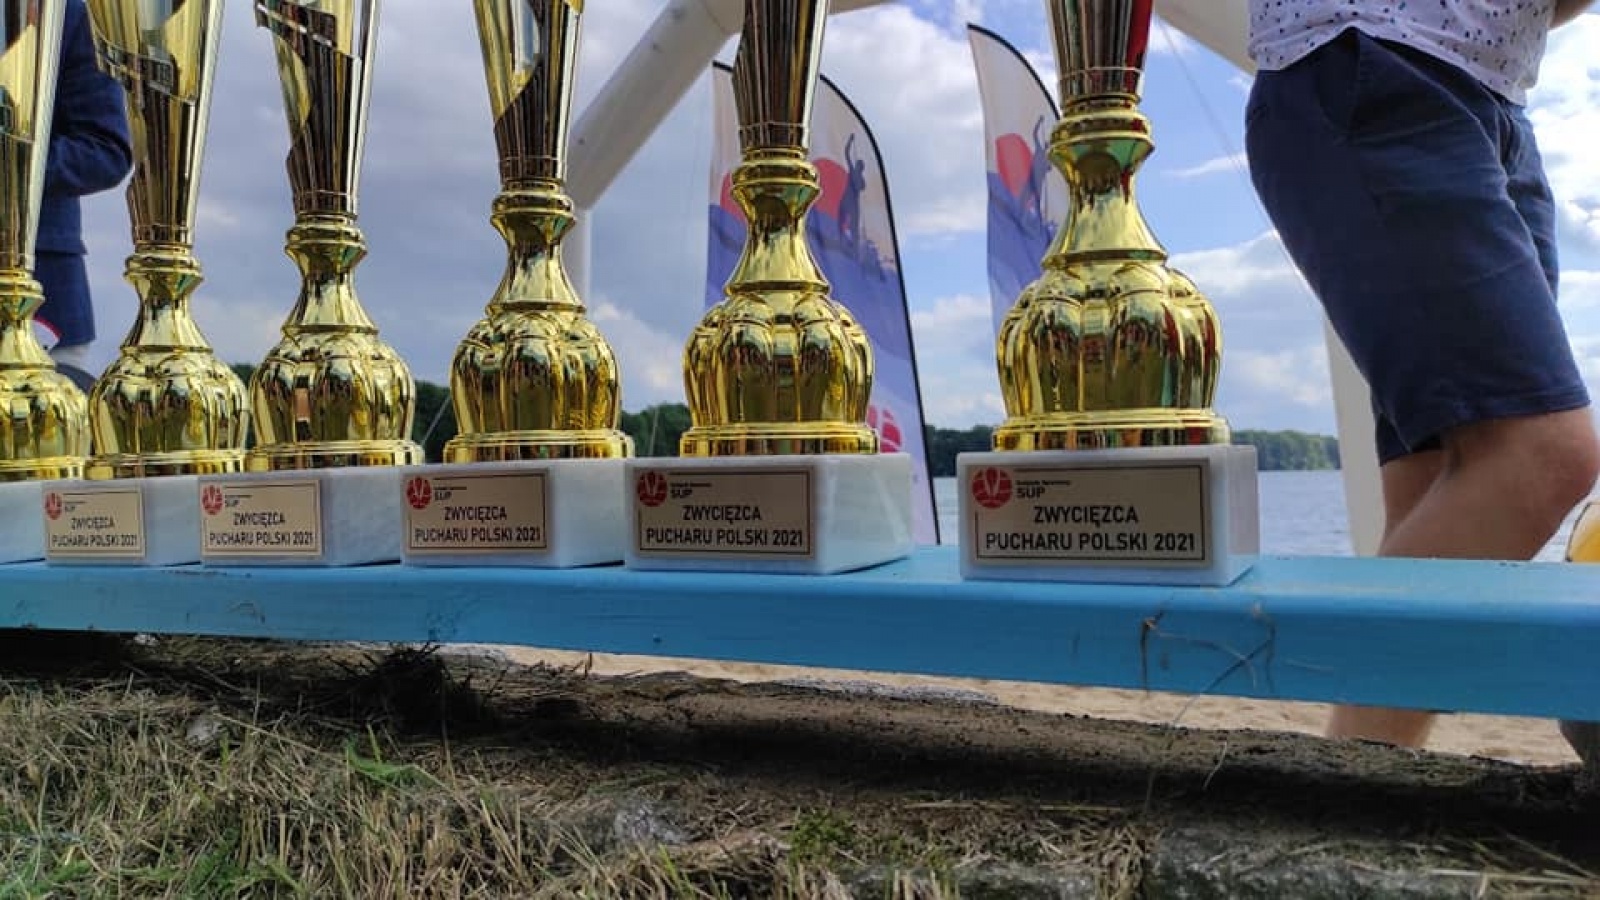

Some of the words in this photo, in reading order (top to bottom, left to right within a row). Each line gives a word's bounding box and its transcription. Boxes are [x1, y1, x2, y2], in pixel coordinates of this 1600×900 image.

[1016, 487, 1045, 498] SUP
[233, 512, 285, 527] ZWYCIĘZCA
[444, 506, 507, 523] ZWYCIĘZCA
[682, 505, 761, 524] ZWYCIĘZCA
[1033, 506, 1139, 527] ZWYCIĘZCA
[209, 532, 253, 545] PUCHARU
[256, 531, 290, 545] POLSKI
[292, 531, 312, 545] 2021
[415, 527, 467, 542] PUCHARU
[471, 527, 513, 542] POLSKI
[515, 527, 540, 542] 2021
[646, 528, 712, 544] PUCHARU
[716, 529, 768, 545] POLSKI
[772, 529, 803, 546] 2021
[986, 532, 1072, 550] PUCHARU
[1079, 533, 1147, 551] POLSKI
[1154, 533, 1195, 552] 2021
